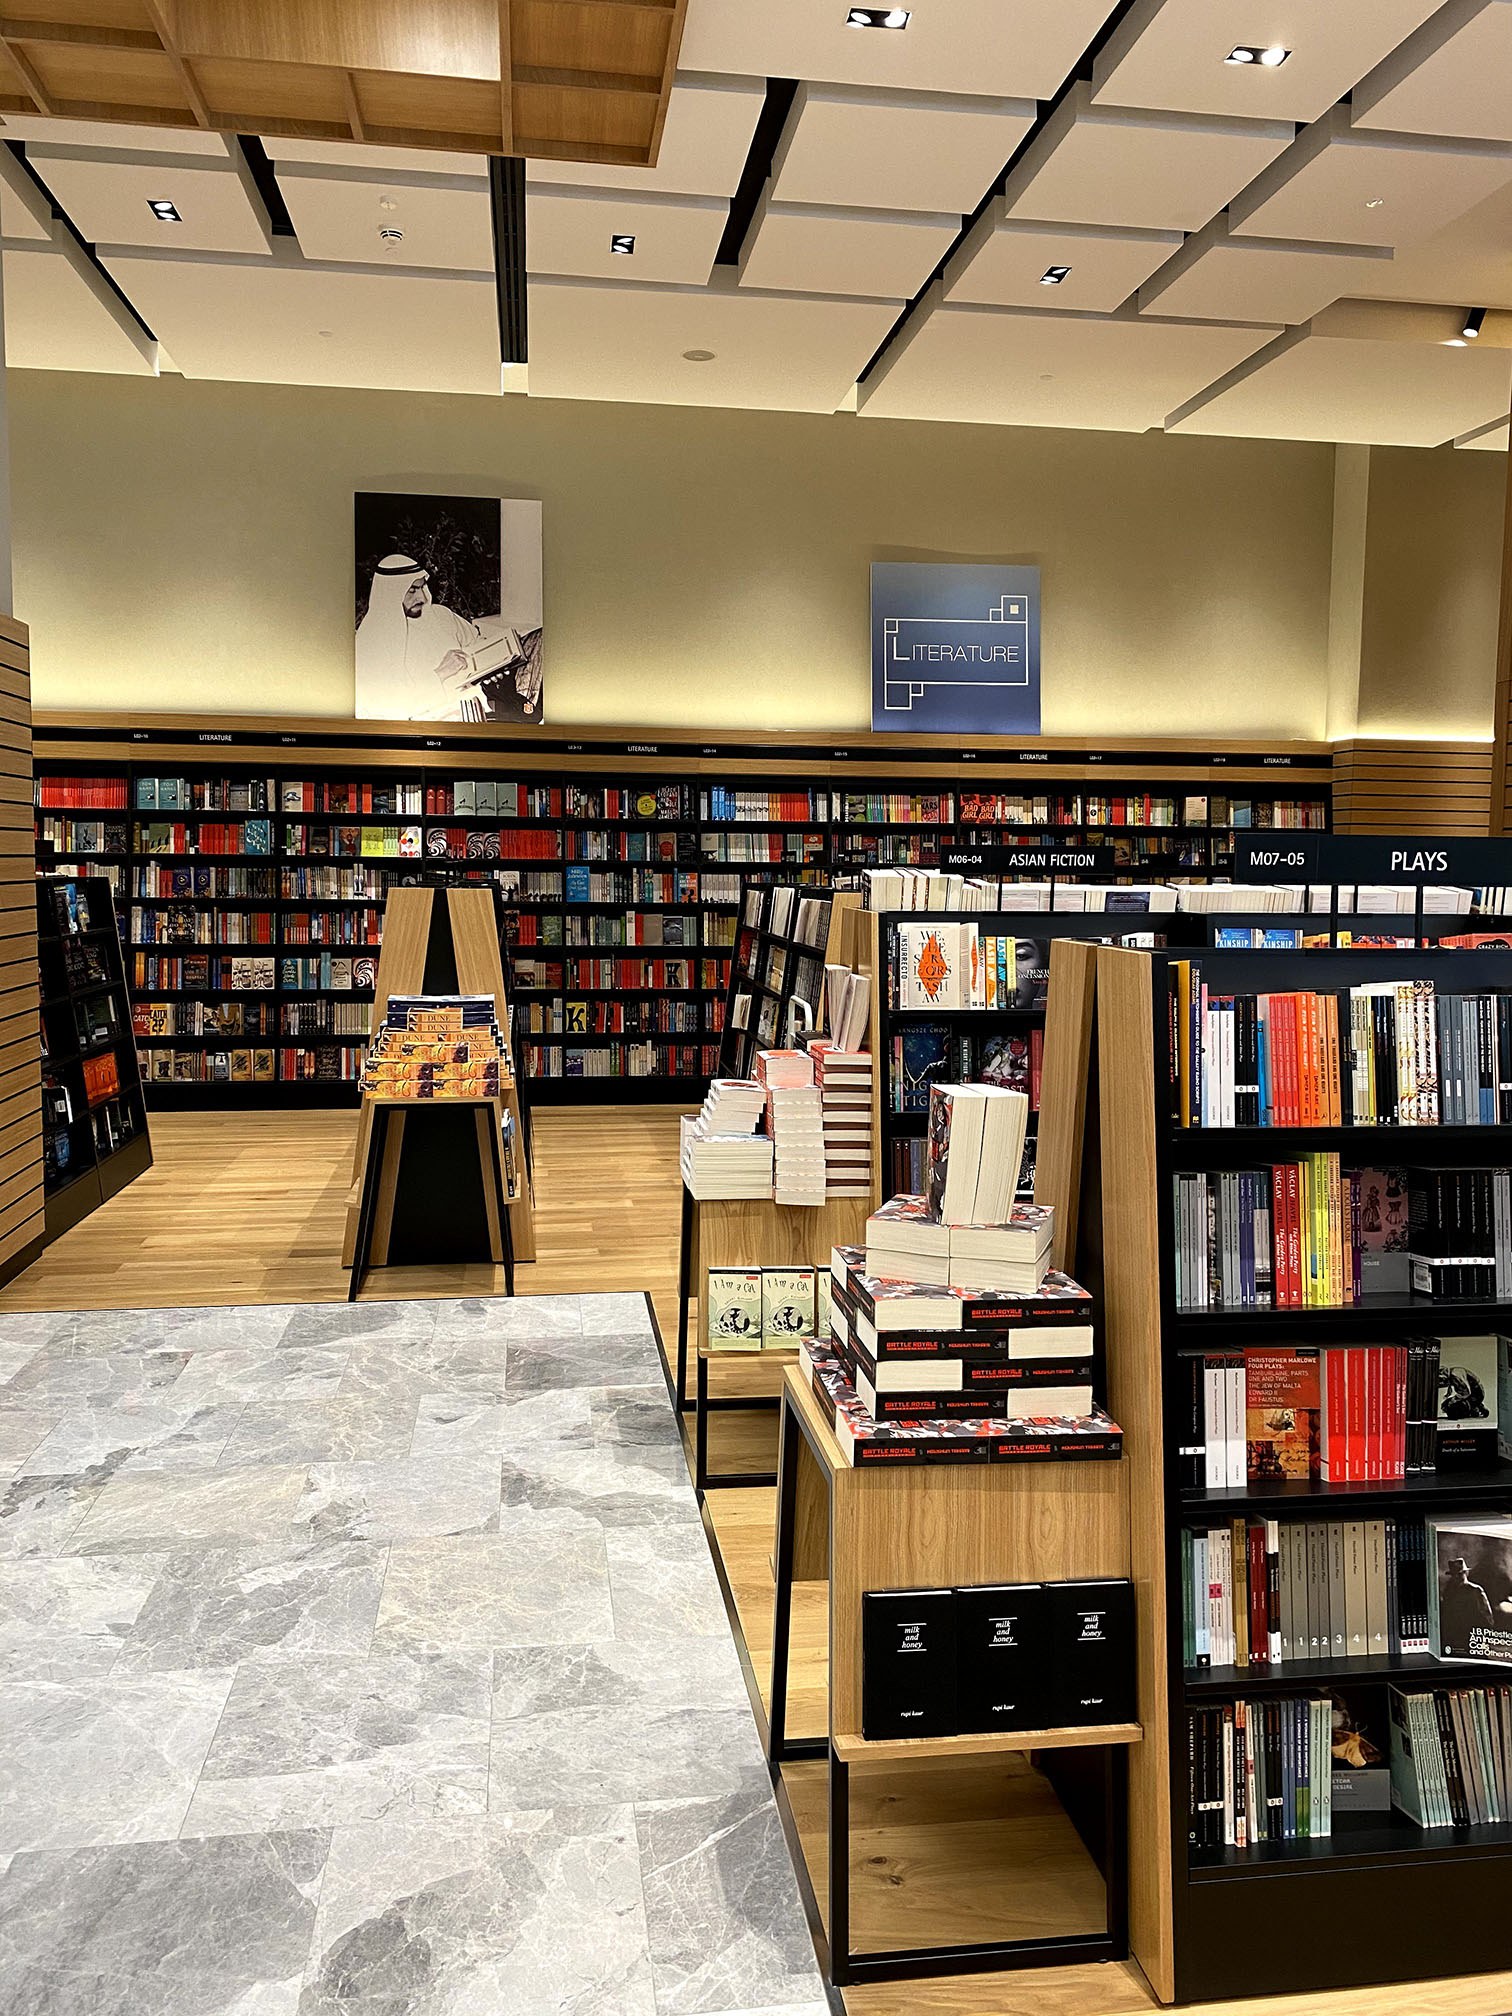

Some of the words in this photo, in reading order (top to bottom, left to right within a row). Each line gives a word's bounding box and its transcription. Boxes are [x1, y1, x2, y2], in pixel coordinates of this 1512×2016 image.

[893, 636, 1019, 663] LITERATURE
[949, 855, 982, 864] M06-04
[1009, 853, 1046, 866] ASIAN
[1050, 854, 1094, 866] FICTION
[1250, 852, 1305, 866] M07-05
[1391, 851, 1448, 872] PLAYS
[918, 942, 946, 953] THE
[1220, 940, 1249, 948] KINSHIP
[998, 939, 1006, 964] TASH
[666, 963, 681, 988] K
[998, 966, 1006, 981] AW
[916, 982, 949, 992] TASH
[922, 993, 942, 1003] AW
[567, 1006, 585, 1032] K
[152, 1019, 164, 1032] 22
[904, 1095, 927, 1107] TIG
[714, 1280, 718, 1289] I
[721, 1279, 733, 1288] Am
[737, 1283, 741, 1291] a
[744, 1282, 756, 1293] Cat
[768, 1279, 771, 1288] I
[775, 1278, 787, 1287] Am
[797, 1281, 808, 1292] Cat
[993, 1635, 1013, 1643] honey
[1082, 1630, 1102, 1638] honey
[1336, 1635, 1342, 1643] 3
[1353, 1634, 1360, 1642] 4
[1375, 1633, 1381, 1641] 4
[1484, 1628, 1512, 1639] Priestle
[902, 1641, 922, 1649] honey
[1322, 1637, 1327, 1645] 2
[1469, 1641, 1489, 1650] Calls
